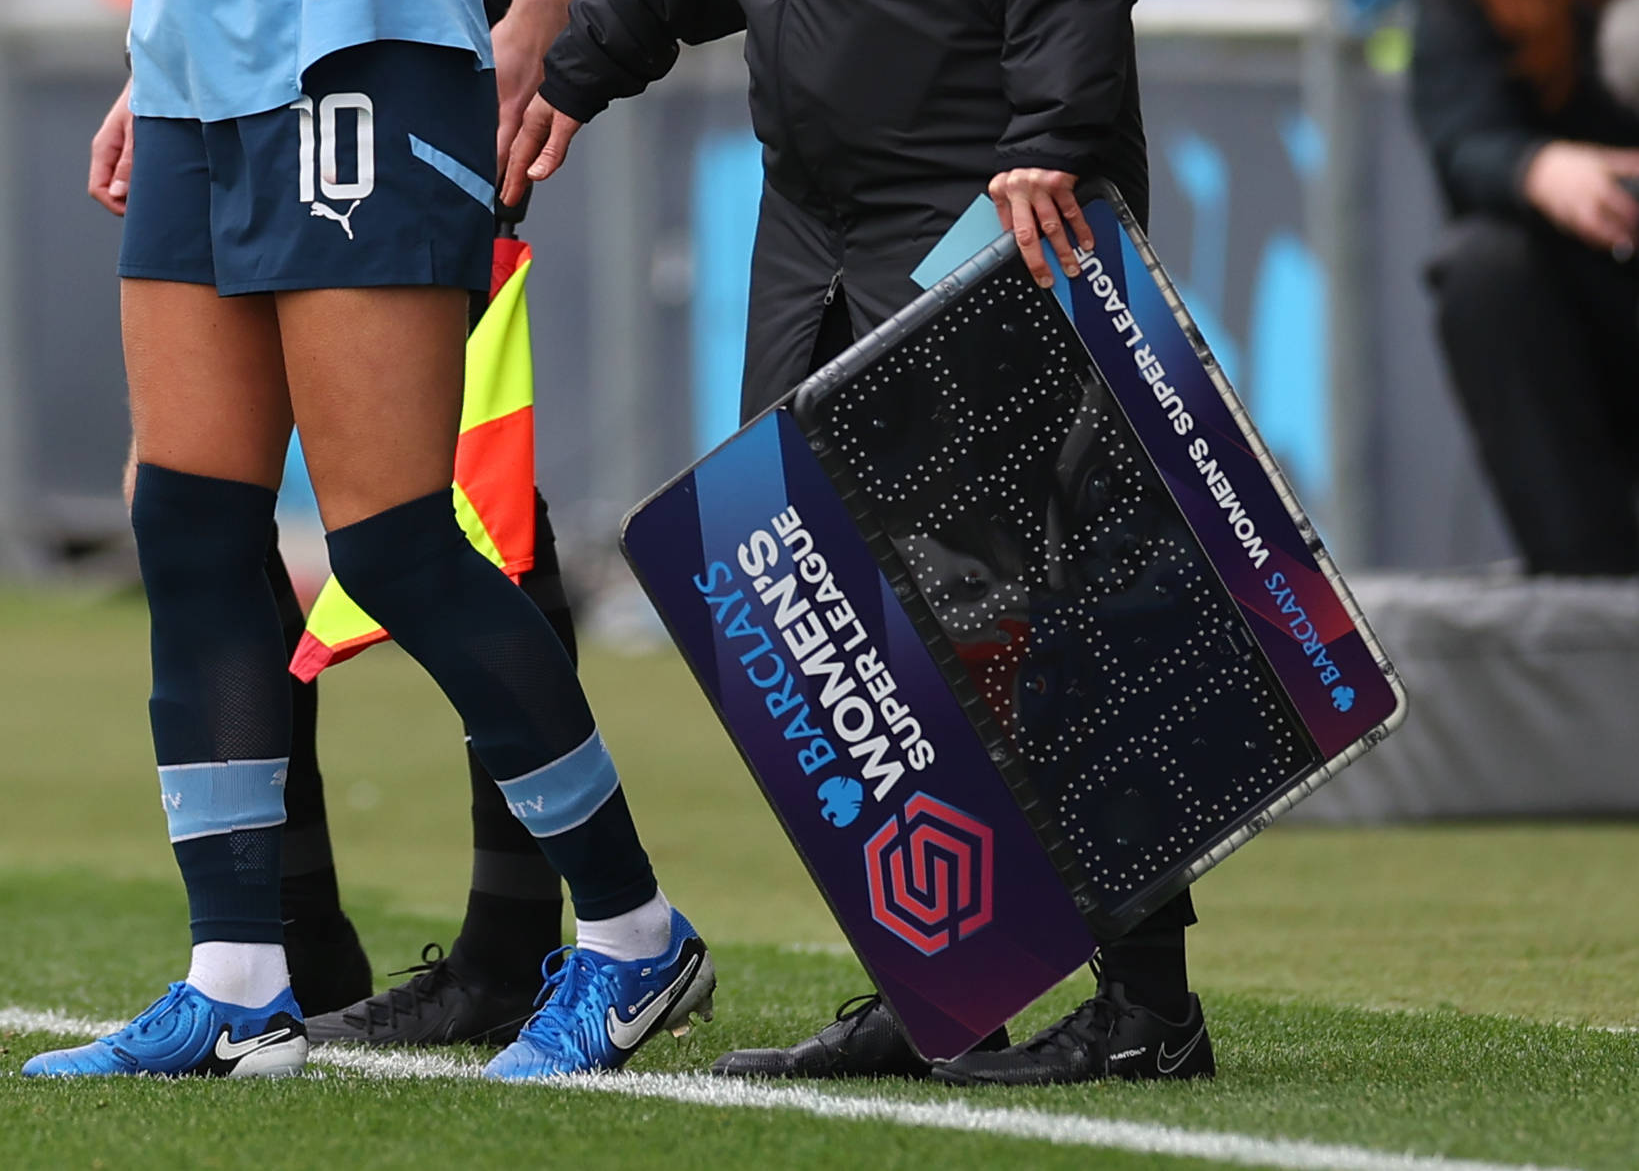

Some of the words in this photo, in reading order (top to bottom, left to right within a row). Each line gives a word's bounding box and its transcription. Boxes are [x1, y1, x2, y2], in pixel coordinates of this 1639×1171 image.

[290, 92, 374, 203] 10
[1134, 344, 1194, 436] SUPER
[1188, 437, 1270, 569] WOMEN'S
[771, 505, 868, 651] LEAGUE
[1265, 572, 1341, 686] BARCLAYS
[693, 560, 838, 776] BARCLAYS
[737, 529, 905, 802] WOMEN'S
[854, 646, 935, 771] SUPER
